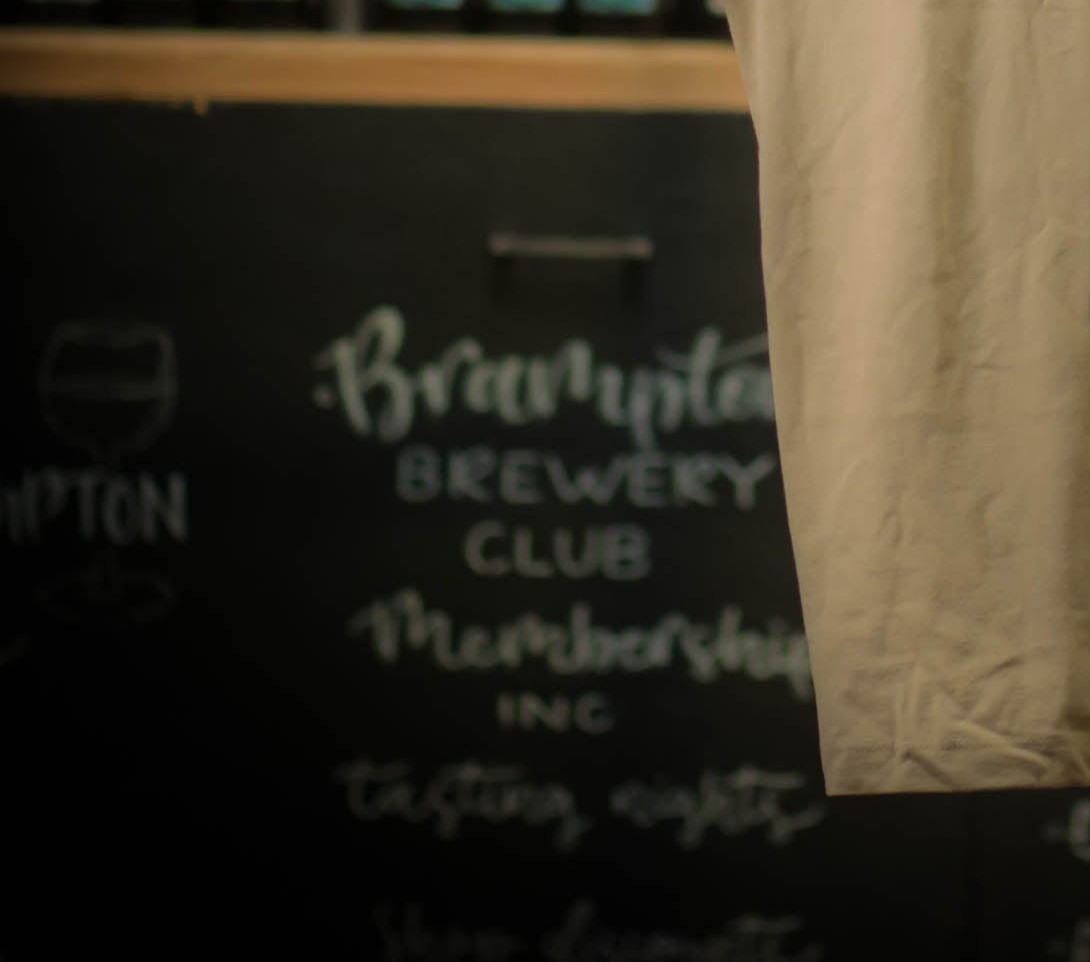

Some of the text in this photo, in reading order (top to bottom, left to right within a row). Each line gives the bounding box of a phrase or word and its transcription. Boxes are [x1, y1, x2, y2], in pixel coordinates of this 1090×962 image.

[395, 443, 778, 512] BREWERY
[462, 519, 654, 582] CLUB
[495, 690, 618, 736] INC
